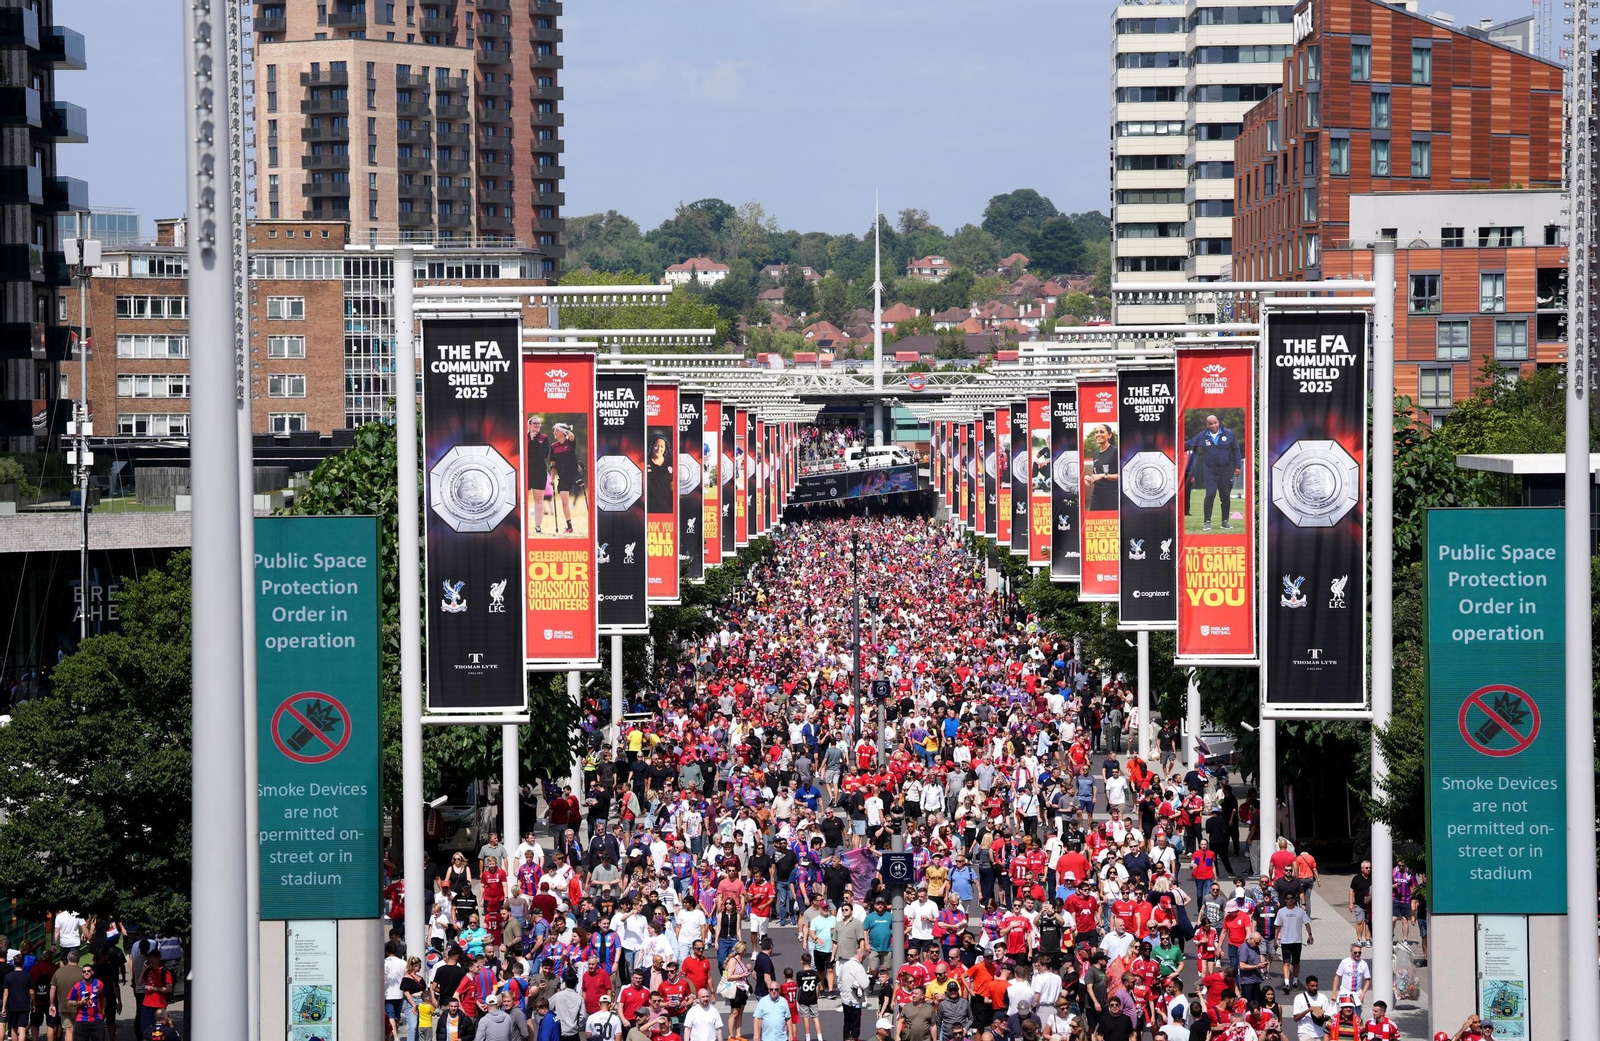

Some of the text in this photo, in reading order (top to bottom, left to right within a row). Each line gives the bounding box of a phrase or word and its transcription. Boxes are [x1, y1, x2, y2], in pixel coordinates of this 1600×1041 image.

[438, 341, 503, 360] THE FA
[1283, 335, 1349, 353] THE FA
[431, 360, 510, 373] COMMUNITY
[1276, 354, 1356, 367] COMMUNITY
[448, 374, 494, 386] SHIELD
[1293, 368, 1339, 380] SHIELD
[455, 387, 488, 398] 2025
[1128, 384, 1170, 396] THE FA
[1300, 381, 1333, 393] 2025
[595, 388, 635, 400] THE FA
[1124, 397, 1174, 405] COMMUNITY
[599, 409, 629, 417] SHIELD
[682, 404, 695, 412] FA
[1135, 405, 1165, 413] SHIELD
[1034, 526, 1051, 535] YO
[648, 532, 673, 544] ALL
[664, 545, 673, 556] DO
[1086, 539, 1119, 554] MOR
[1185, 546, 1245, 554] THERE'S
[528, 551, 588, 562] CELEBRATING
[1439, 545, 1556, 563] Public Space
[254, 554, 367, 572] Public Space
[1185, 554, 1245, 572] NO GAME
[528, 562, 588, 581] OUR
[1186, 572, 1245, 588] WITHOUT
[1448, 572, 1547, 587] Protection
[262, 580, 358, 595] Protection
[528, 581, 588, 598] GRASSROOTS
[1186, 588, 1245, 607] YOU
[529, 599, 589, 611] VOLUNTEERS
[1458, 598, 1536, 614] Order in
[272, 606, 347, 622] Order in
[1452, 625, 1544, 644] operation
[265, 634, 355, 652] operation
[1442, 776, 1558, 790] Smoke Devices
[257, 783, 367, 797] Smoke Devices
[284, 806, 339, 818] are not
[1472, 800, 1528, 812] are not
[260, 827, 364, 844] permitted on-
[1447, 821, 1554, 837] permitted on-
[269, 850, 352, 863] street or in
[1458, 844, 1543, 857] street or in
[1016, 866, 1026, 878] 11
[1470, 866, 1532, 879] stadium
[281, 872, 342, 886] stadium
[802, 980, 815, 992] 66
[594, 1023, 612, 1040] 30
